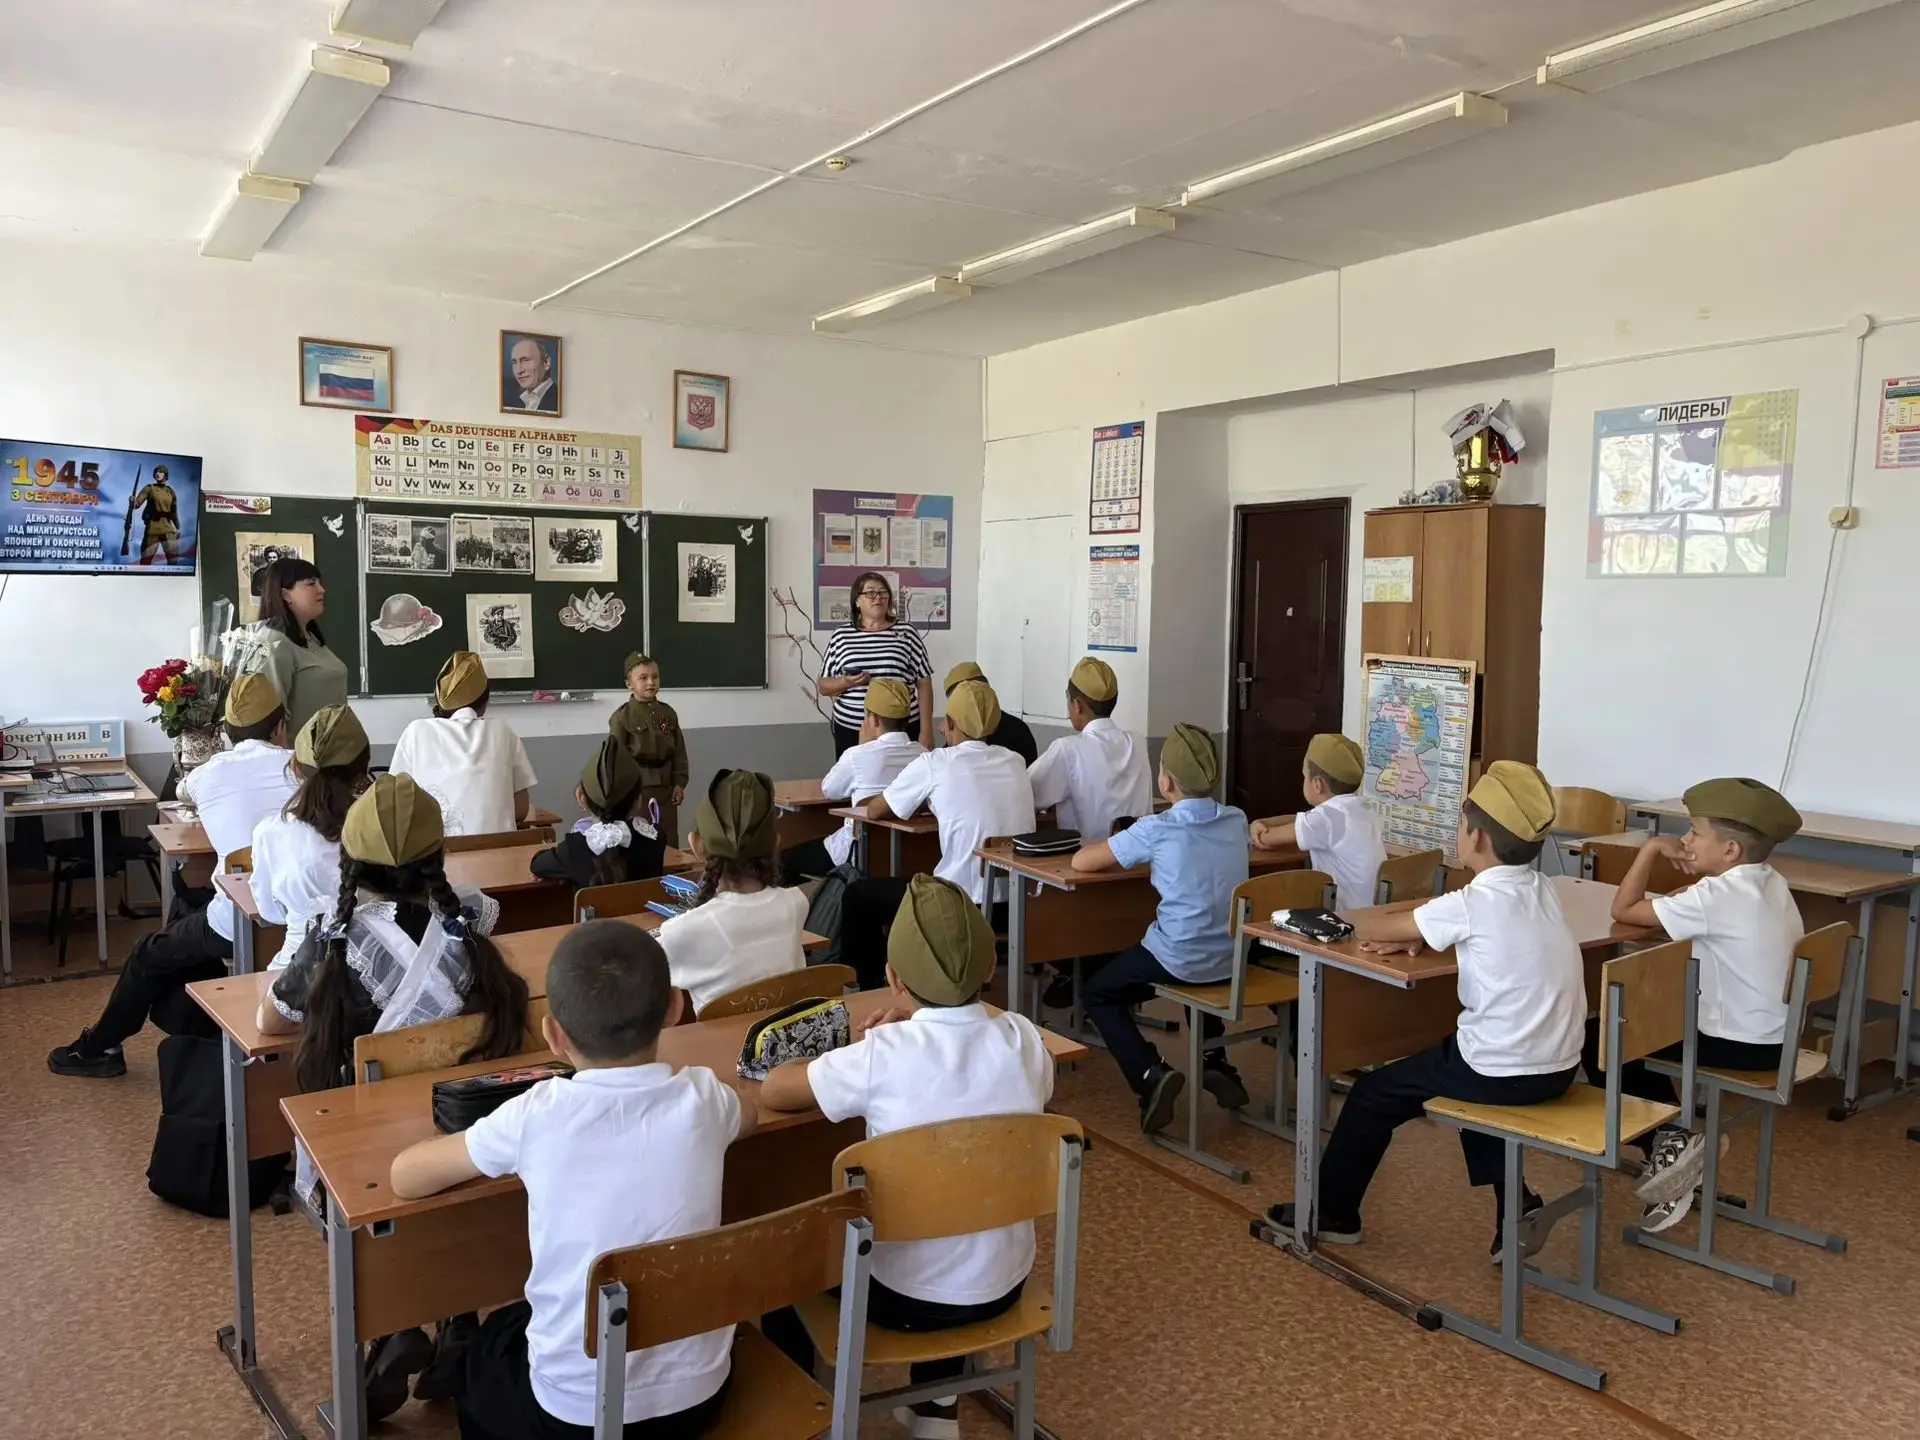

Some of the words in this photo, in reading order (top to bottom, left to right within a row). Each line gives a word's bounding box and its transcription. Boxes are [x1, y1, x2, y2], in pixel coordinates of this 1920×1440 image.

[1657, 402, 1726, 423] ЛИДЕРЫ
[430, 424, 453, 434] DAS
[455, 426, 516, 438] DEUTSCHE
[519, 430, 577, 442] ALPHABET
[374, 434, 391, 445] Aa
[403, 436, 419, 447] Bb
[432, 438, 446, 449] Cc
[458, 440, 474, 450] Dd
[486, 442, 499, 452] Ee
[513, 443, 525, 453] Ff
[537, 445, 552, 456] Gg
[562, 447, 577, 457] Hh
[614, 450, 623, 461] Jj
[12, 456, 100, 490] 1945
[375, 456, 391, 466] Kk
[429, 459, 449, 469] Mm
[458, 461, 475, 471] Nn
[485, 462, 501, 472] Oo
[512, 464, 527, 475] Pp
[537, 465, 553, 476] Qq
[564, 467, 576, 476] Rr
[589, 468, 601, 478] Ss
[614, 470, 625, 479] Tt
[375, 476, 392, 487] Uu
[404, 478, 420, 488] Vv
[429, 479, 450, 490] Ww
[459, 481, 474, 491] Xx
[487, 482, 500, 493] Yy
[513, 483, 526, 494] Zz
[11, 489, 20, 502] 3
[25, 490, 99, 506] СЕНТЯБРЯ
[25, 514, 46, 524] ДЕНЬ
[49, 515, 82, 525] ПОБЕДЫ
[8, 526, 24, 535] НАД
[27, 525, 97, 536] МИЛИТАРИСТСКОЙ
[4, 536, 42, 546] ЯПОНИЕЙ
[45, 537, 51, 546] И
[53, 539, 100, 547] ОКОНЧАНИЯ
[0, 548, 32, 558] ВТОРОЙ
[34, 548, 72, 559] МИРОВОЙ
[75, 549, 103, 559] ВОЙНЫ
[4, 731, 87, 743] очетания
